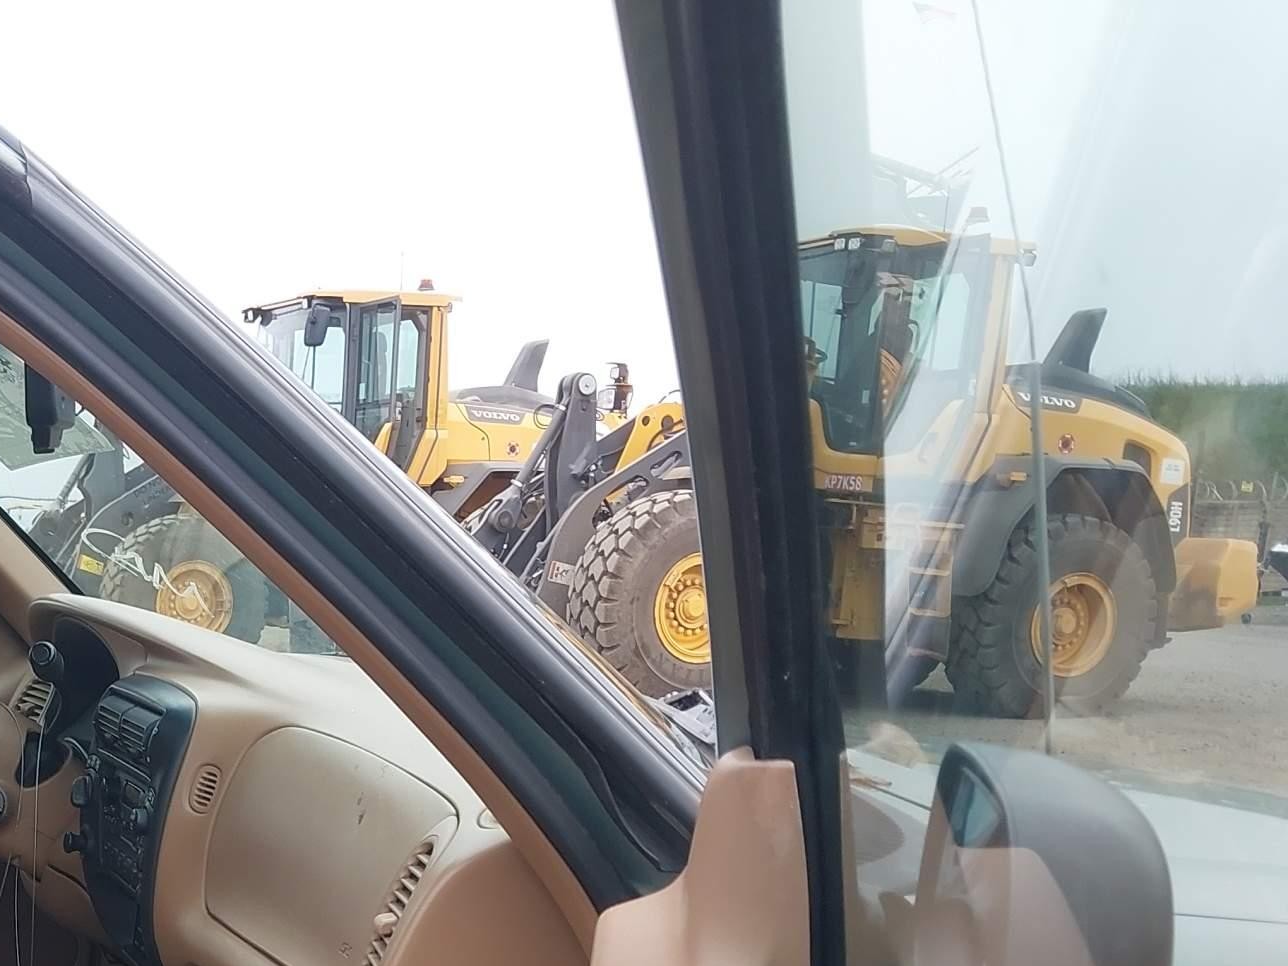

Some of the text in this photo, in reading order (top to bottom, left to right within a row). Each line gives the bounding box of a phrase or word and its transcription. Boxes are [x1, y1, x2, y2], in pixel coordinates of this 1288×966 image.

[1017, 391, 1076, 409] VLVO
[471, 410, 520, 421] VOLVO
[1168, 501, 1184, 533] L90H
